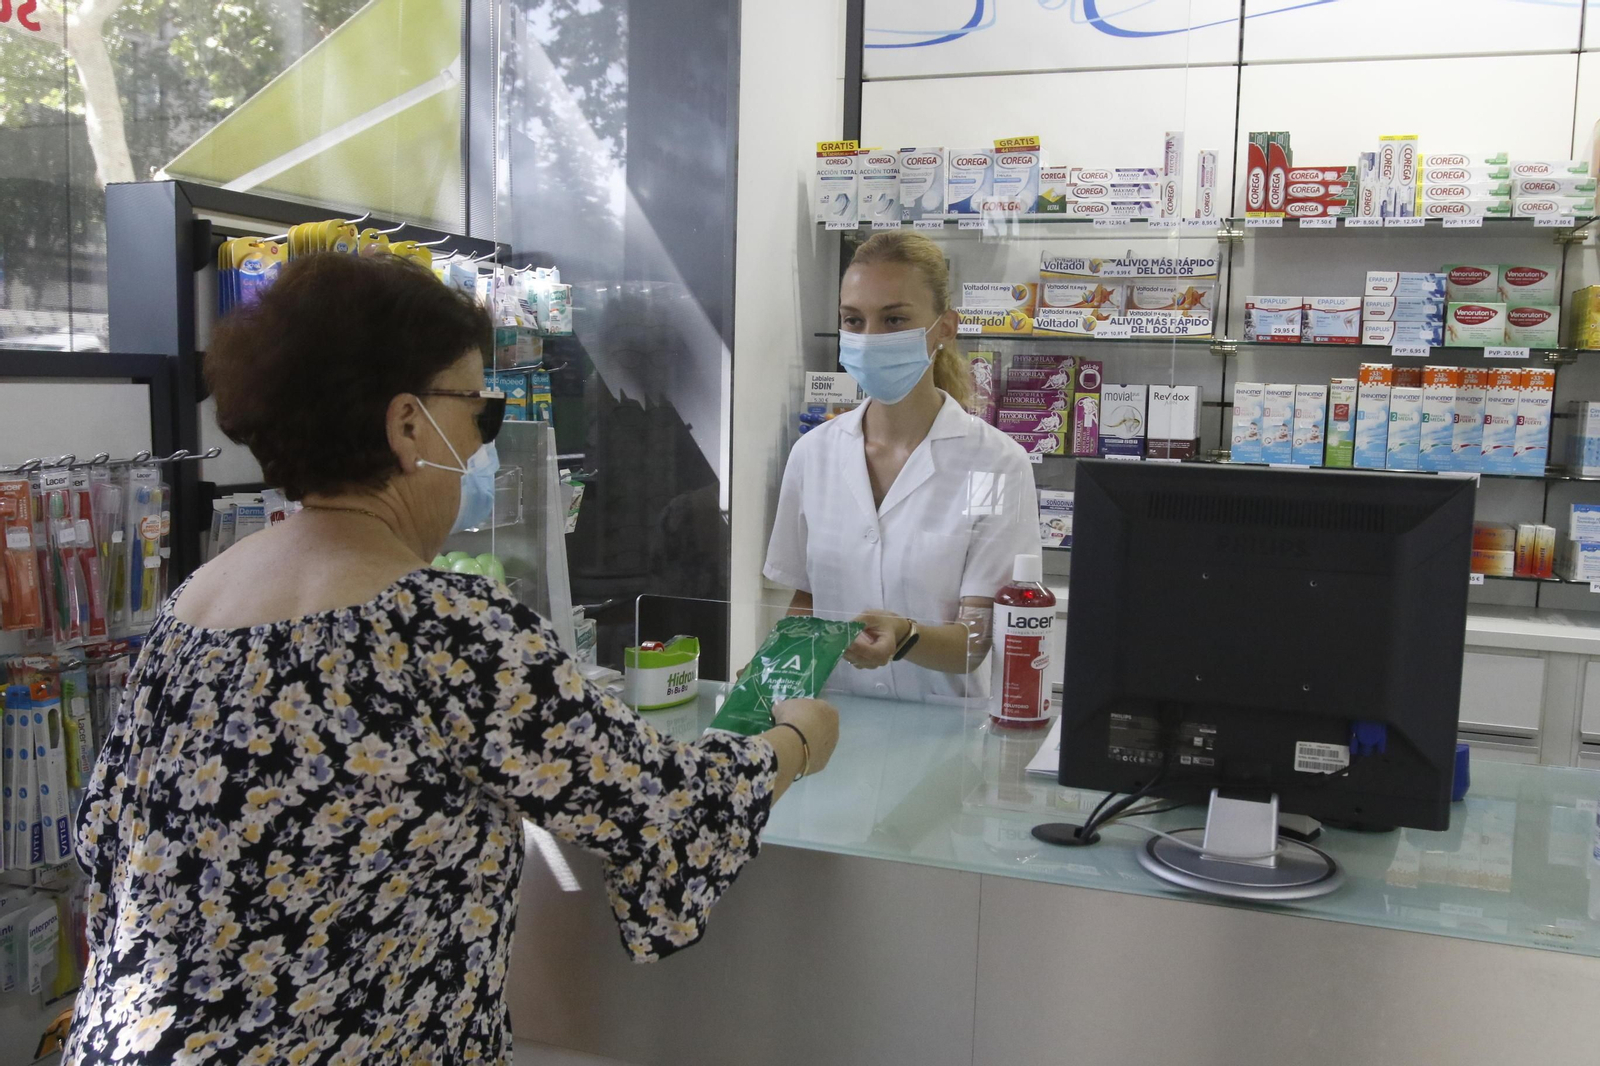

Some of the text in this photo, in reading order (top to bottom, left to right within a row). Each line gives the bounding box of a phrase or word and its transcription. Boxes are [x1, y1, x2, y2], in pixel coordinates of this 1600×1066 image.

[821, 142, 854, 150] GRATIS
[1000, 138, 1034, 146] GRATIS
[906, 158, 937, 166] COREGA
[957, 158, 987, 166] COREGA
[1002, 156, 1032, 164] COREGA
[1403, 148, 1412, 180] COREGA
[1430, 157, 1464, 165] COREGA
[1431, 172, 1464, 180] COREGA
[1251, 173, 1259, 204] COREGA
[1271, 173, 1280, 205] COREGA
[983, 202, 1022, 211] COREGA
[1430, 205, 1464, 214] COREGA
[1044, 261, 1084, 270] Voltadol
[1116, 258, 1214, 267] ALIVIO MÁS RÁPIDO
[959, 316, 1005, 326] Voltadol
[1036, 318, 1078, 328] Voltadol
[1146, 316, 1167, 326] MÁS
[1170, 317, 1209, 326] RÁPIDO
[46, 477, 67, 486] Lacer
[1007, 612, 1053, 629] Lacer
[78, 718, 86, 745] Lacer
[30, 916, 57, 937] interprox
